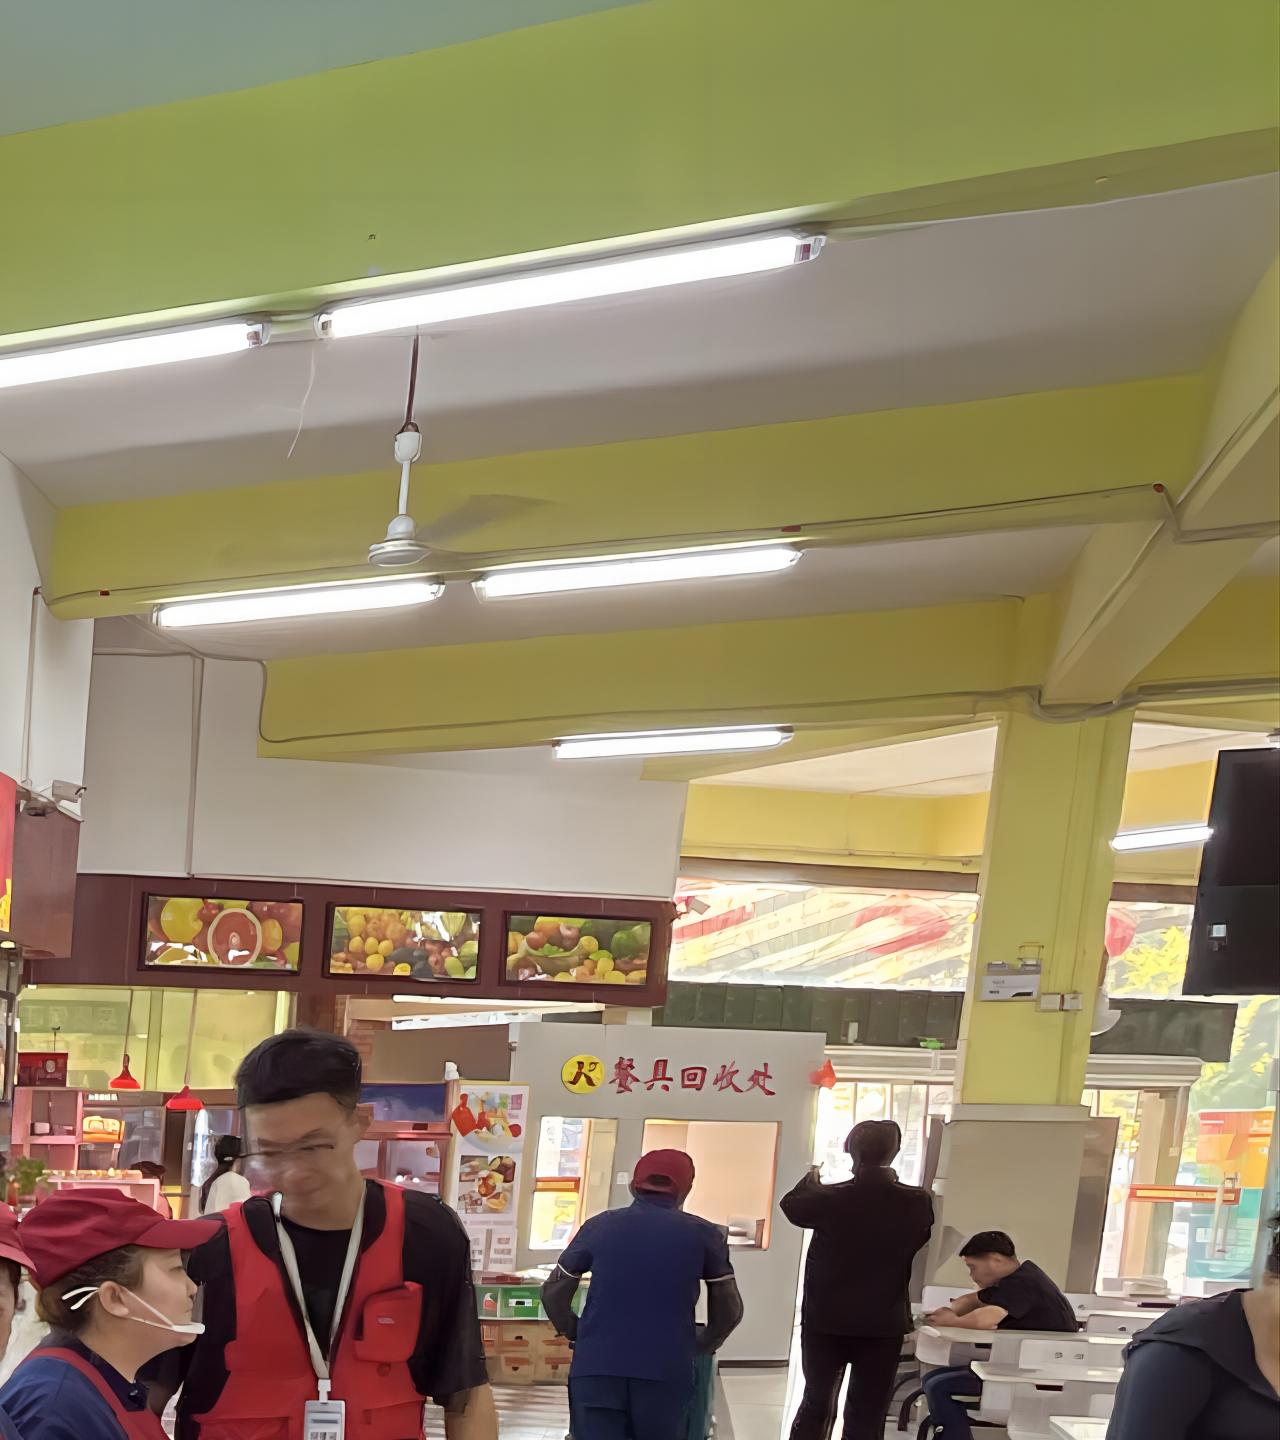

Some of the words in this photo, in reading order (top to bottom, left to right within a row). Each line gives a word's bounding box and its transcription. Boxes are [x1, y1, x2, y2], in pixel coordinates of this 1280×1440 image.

[608, 1056, 776, 1096] 餐具回收处
